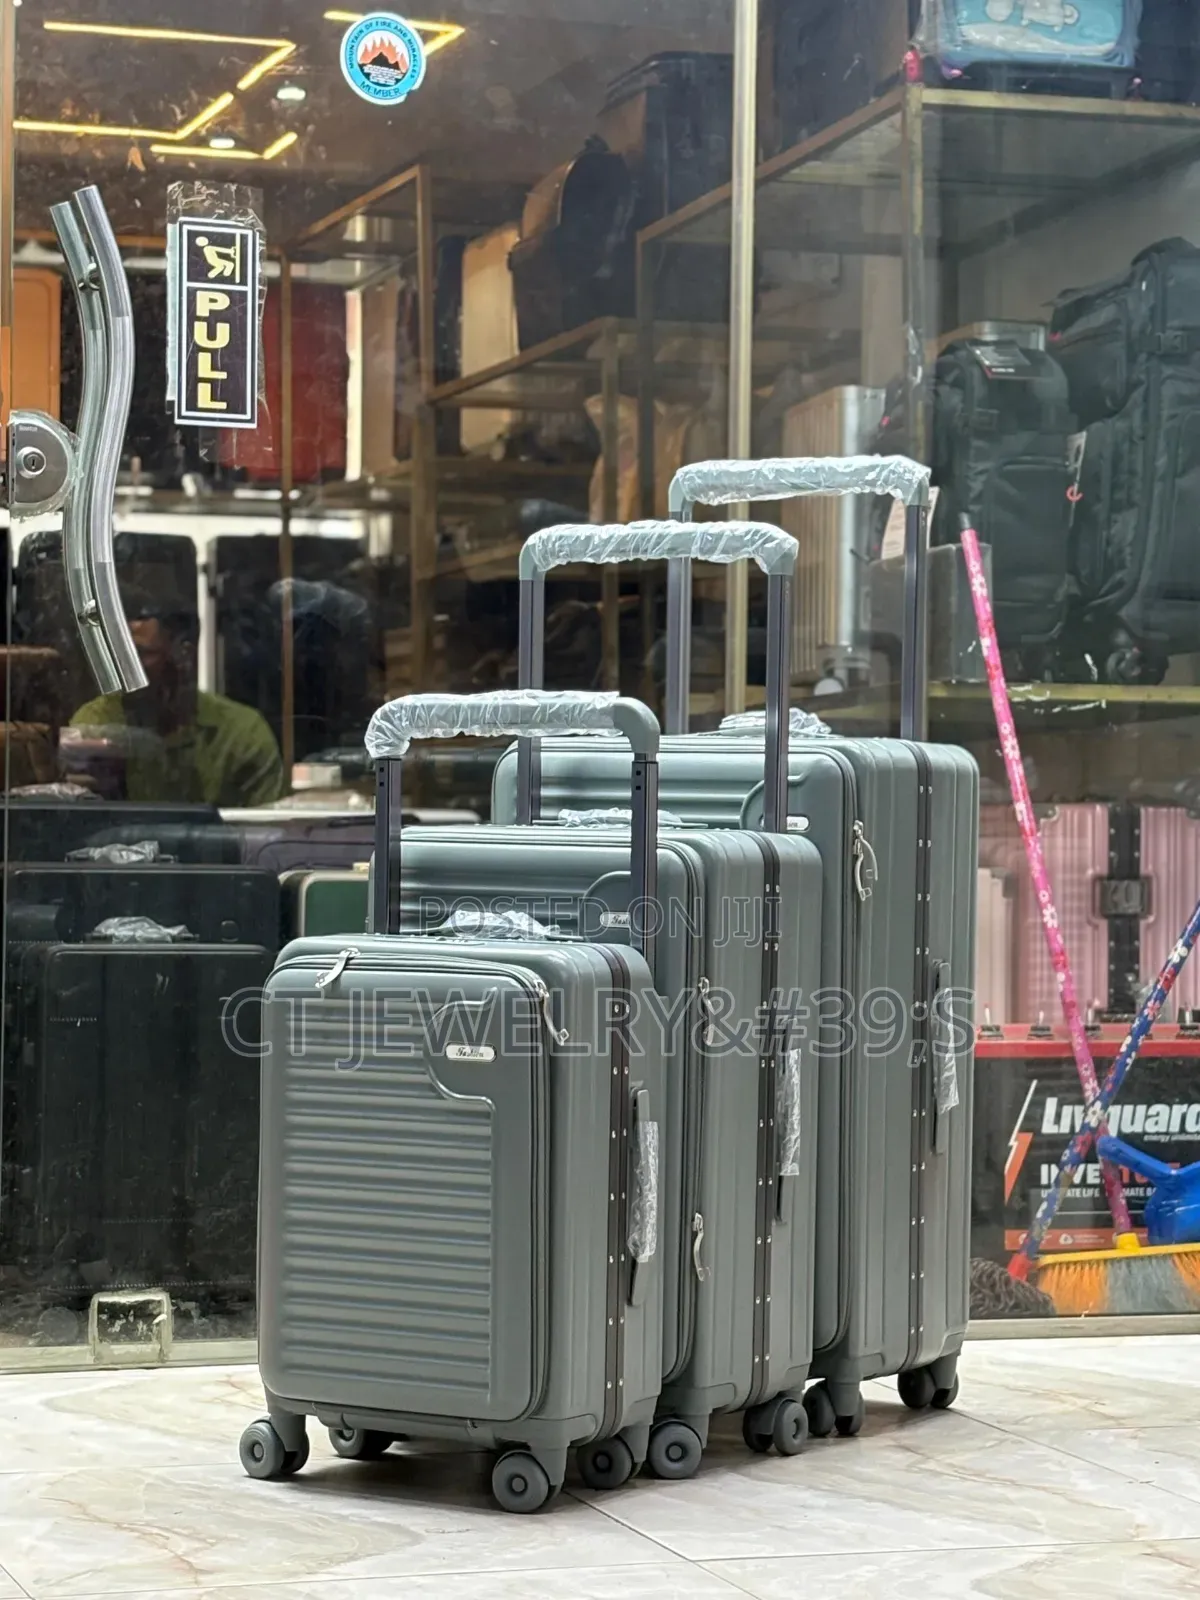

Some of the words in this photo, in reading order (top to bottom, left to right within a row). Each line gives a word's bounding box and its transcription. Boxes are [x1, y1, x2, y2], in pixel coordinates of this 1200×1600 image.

[347, 28, 365, 70] MOUNTAIN
[364, 21, 374, 31] OF
[375, 20, 392, 29] FIRE
[393, 24, 408, 38] AND
[407, 38, 419, 79] MIRACLES
[359, 80, 402, 98] MEMBER
[194, 290, 230, 410] PULL
[455, 1046, 485, 1058] Fashion
